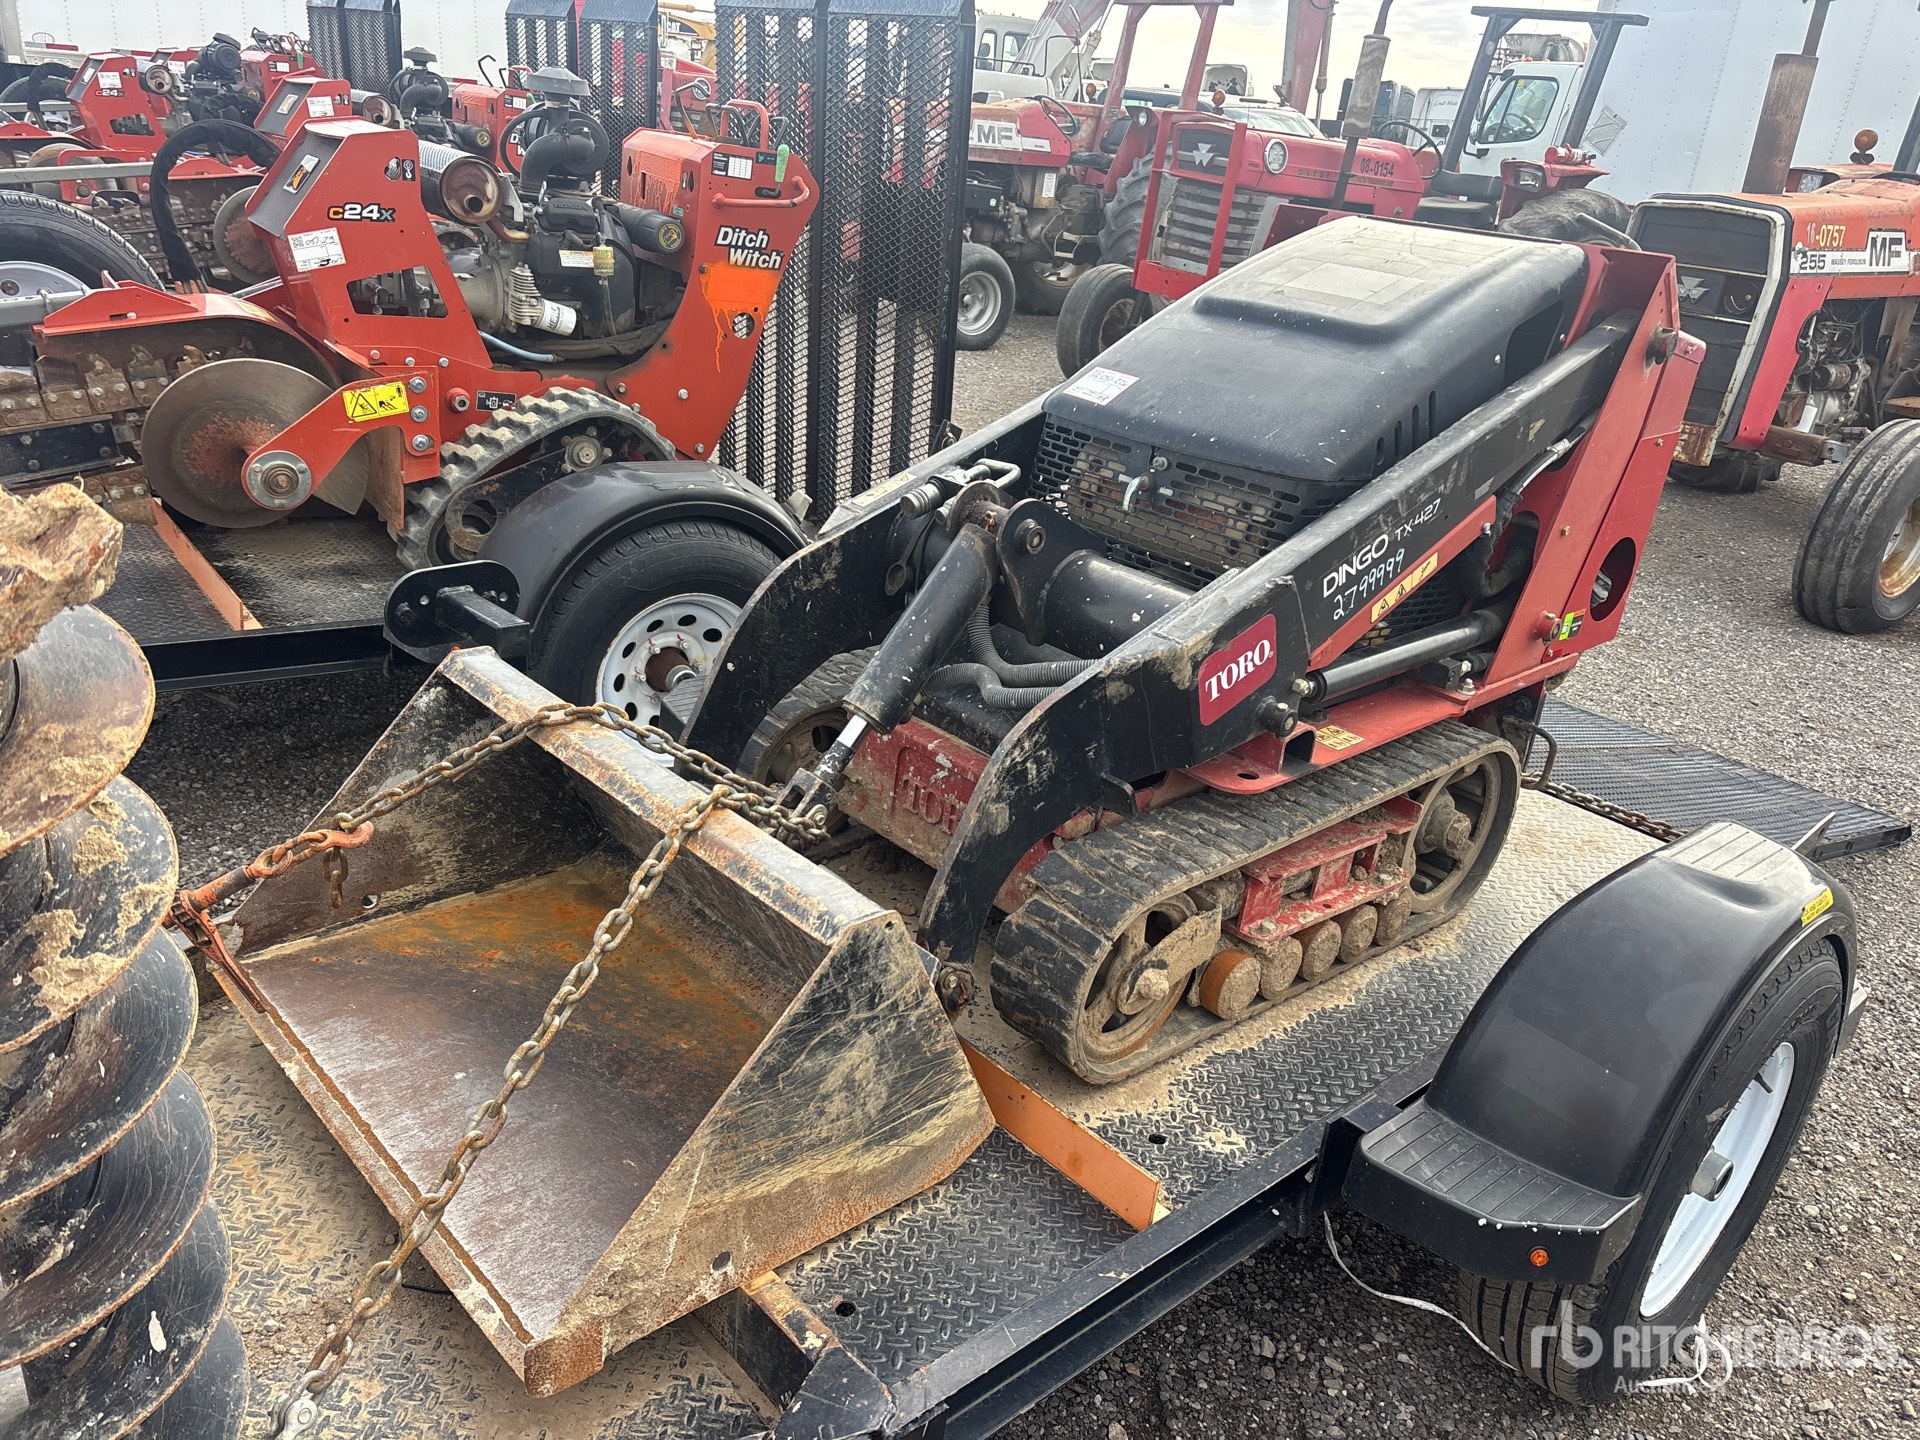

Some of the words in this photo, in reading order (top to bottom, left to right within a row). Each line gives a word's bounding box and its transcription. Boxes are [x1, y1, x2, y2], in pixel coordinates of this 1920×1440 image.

[976, 124, 1013, 145] MF
[1360, 157, 1395, 178] 08-0154
[715, 225, 769, 251] Ditch
[728, 246, 781, 271] Witch
[1799, 253, 1827, 271] 255
[1869, 237, 1903, 267] MF
[1323, 534, 1389, 599] DINGO
[1333, 547, 1405, 621] 2799999
[1204, 639, 1272, 703] TORO
